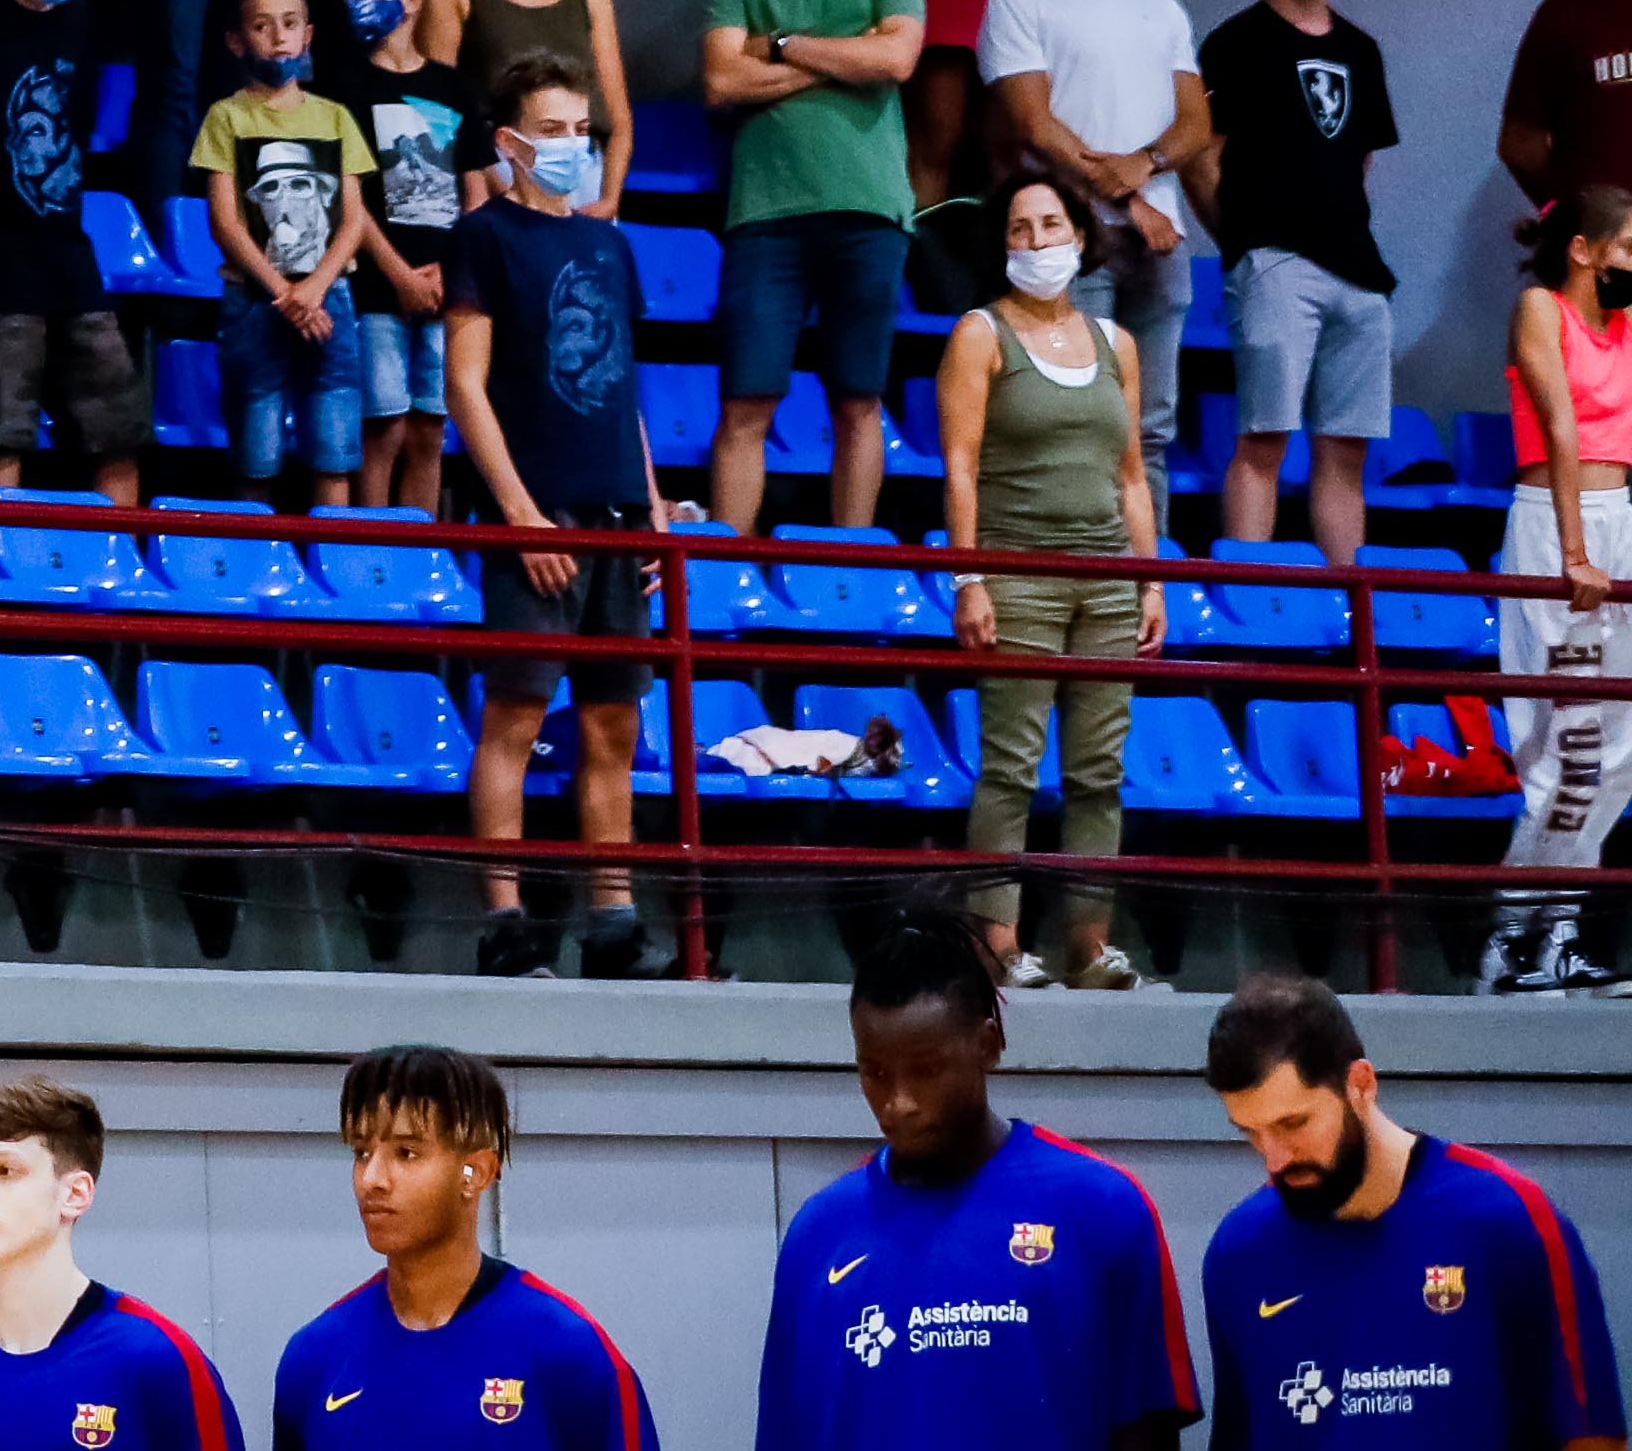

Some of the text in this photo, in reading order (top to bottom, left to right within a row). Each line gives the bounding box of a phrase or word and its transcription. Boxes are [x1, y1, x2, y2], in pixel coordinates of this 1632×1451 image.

[907, 1299, 1029, 1329] Assistència
[1341, 1363, 1451, 1391] Assistència
[1340, 1391, 1414, 1417] Sanitària
